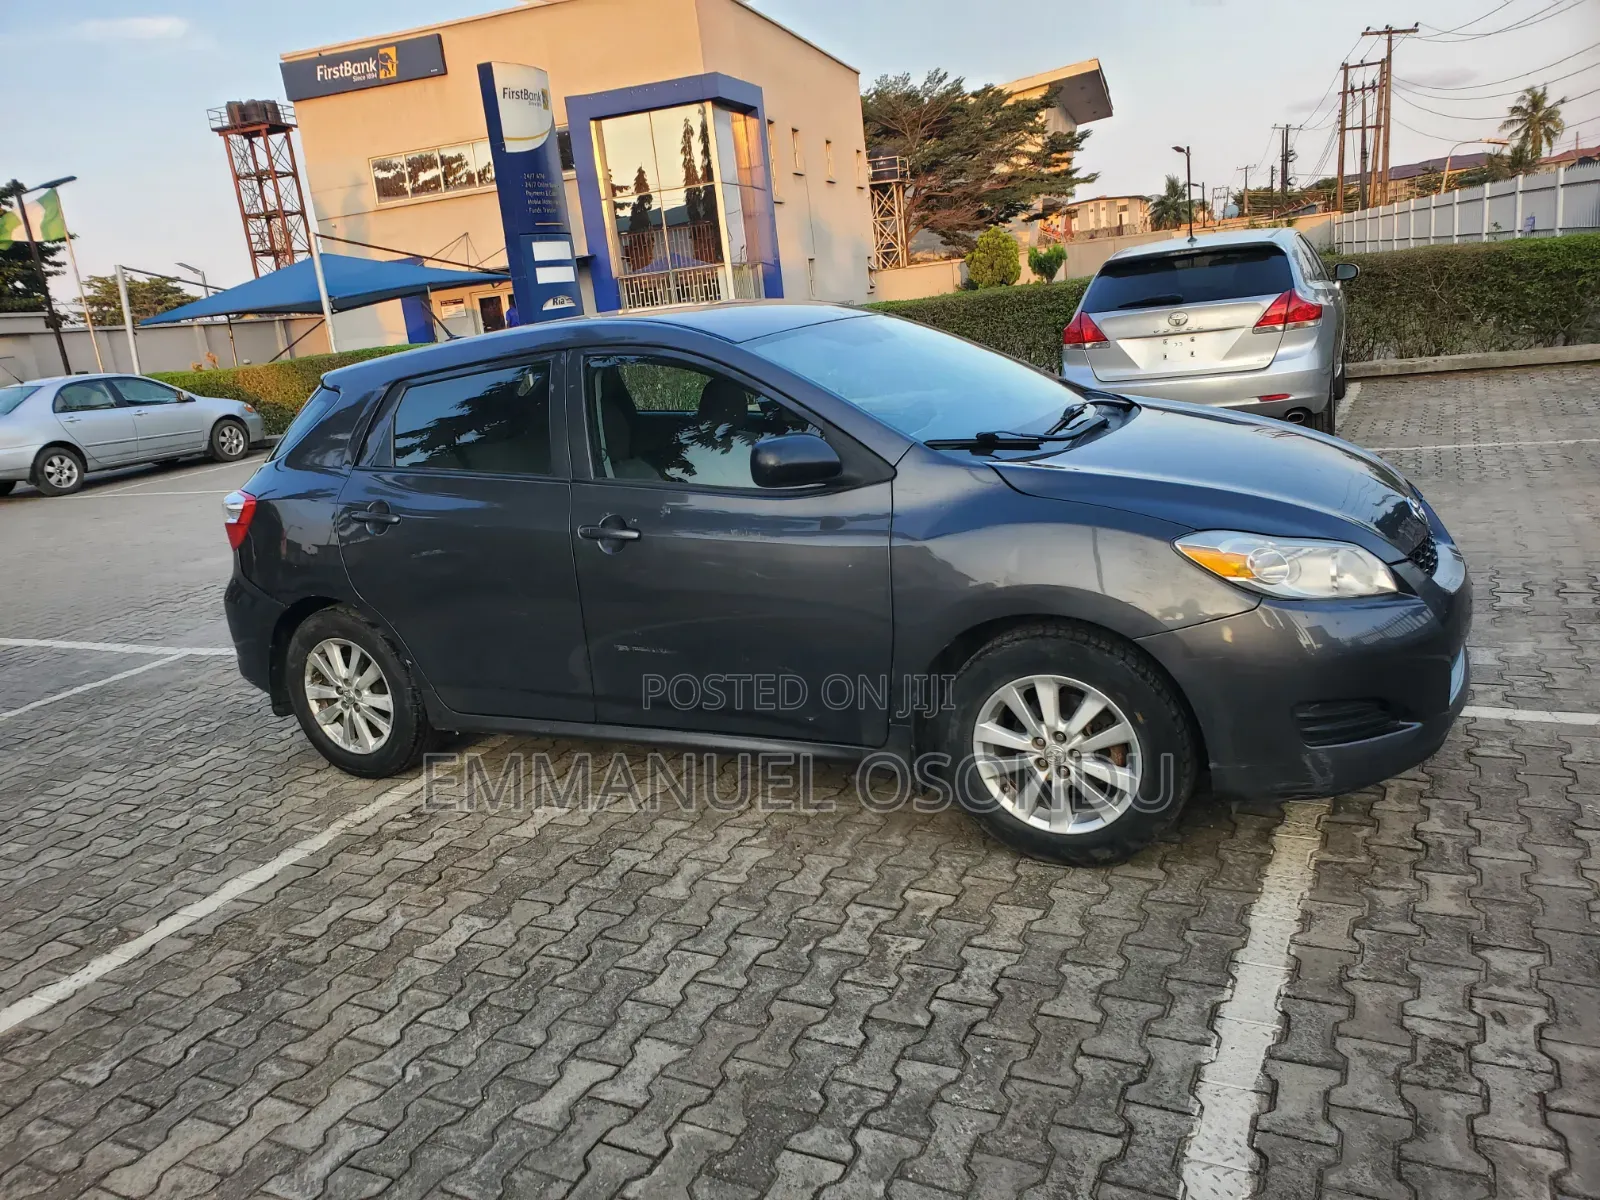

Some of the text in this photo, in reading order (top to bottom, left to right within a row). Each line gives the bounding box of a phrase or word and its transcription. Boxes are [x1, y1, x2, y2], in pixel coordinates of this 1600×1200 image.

[316, 57, 377, 81] FirstBank
[352, 75, 366, 83] Since
[502, 87, 542, 102] FirstBank
[552, 297, 565, 306] Ria
